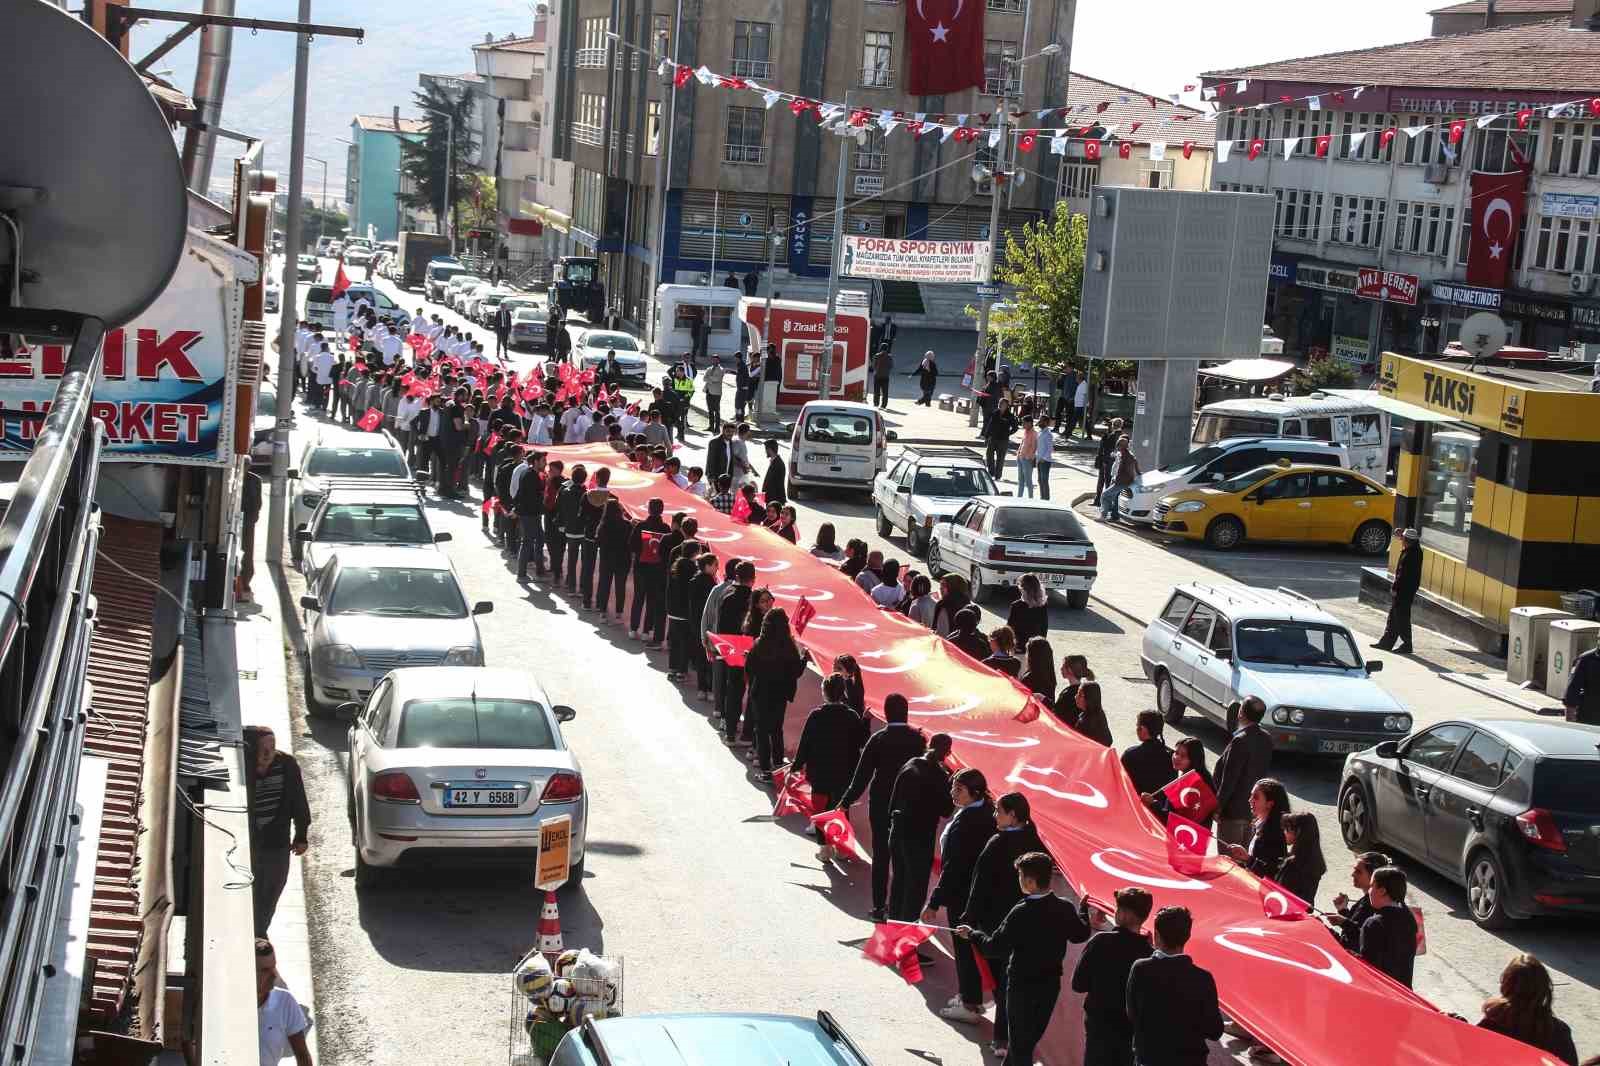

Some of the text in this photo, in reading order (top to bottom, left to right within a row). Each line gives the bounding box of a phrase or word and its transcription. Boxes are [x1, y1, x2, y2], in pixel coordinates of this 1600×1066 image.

[1400, 98, 1585, 119] YUNAK BELEDİYSİ
[857, 238, 895, 252] FORA
[900, 240, 937, 254] SPOR
[1382, 272, 1415, 298] BERBER
[793, 322, 816, 332] Ziraat
[22, 401, 209, 443] MRKET
[454, 791, 515, 803] 42 Y 6588
